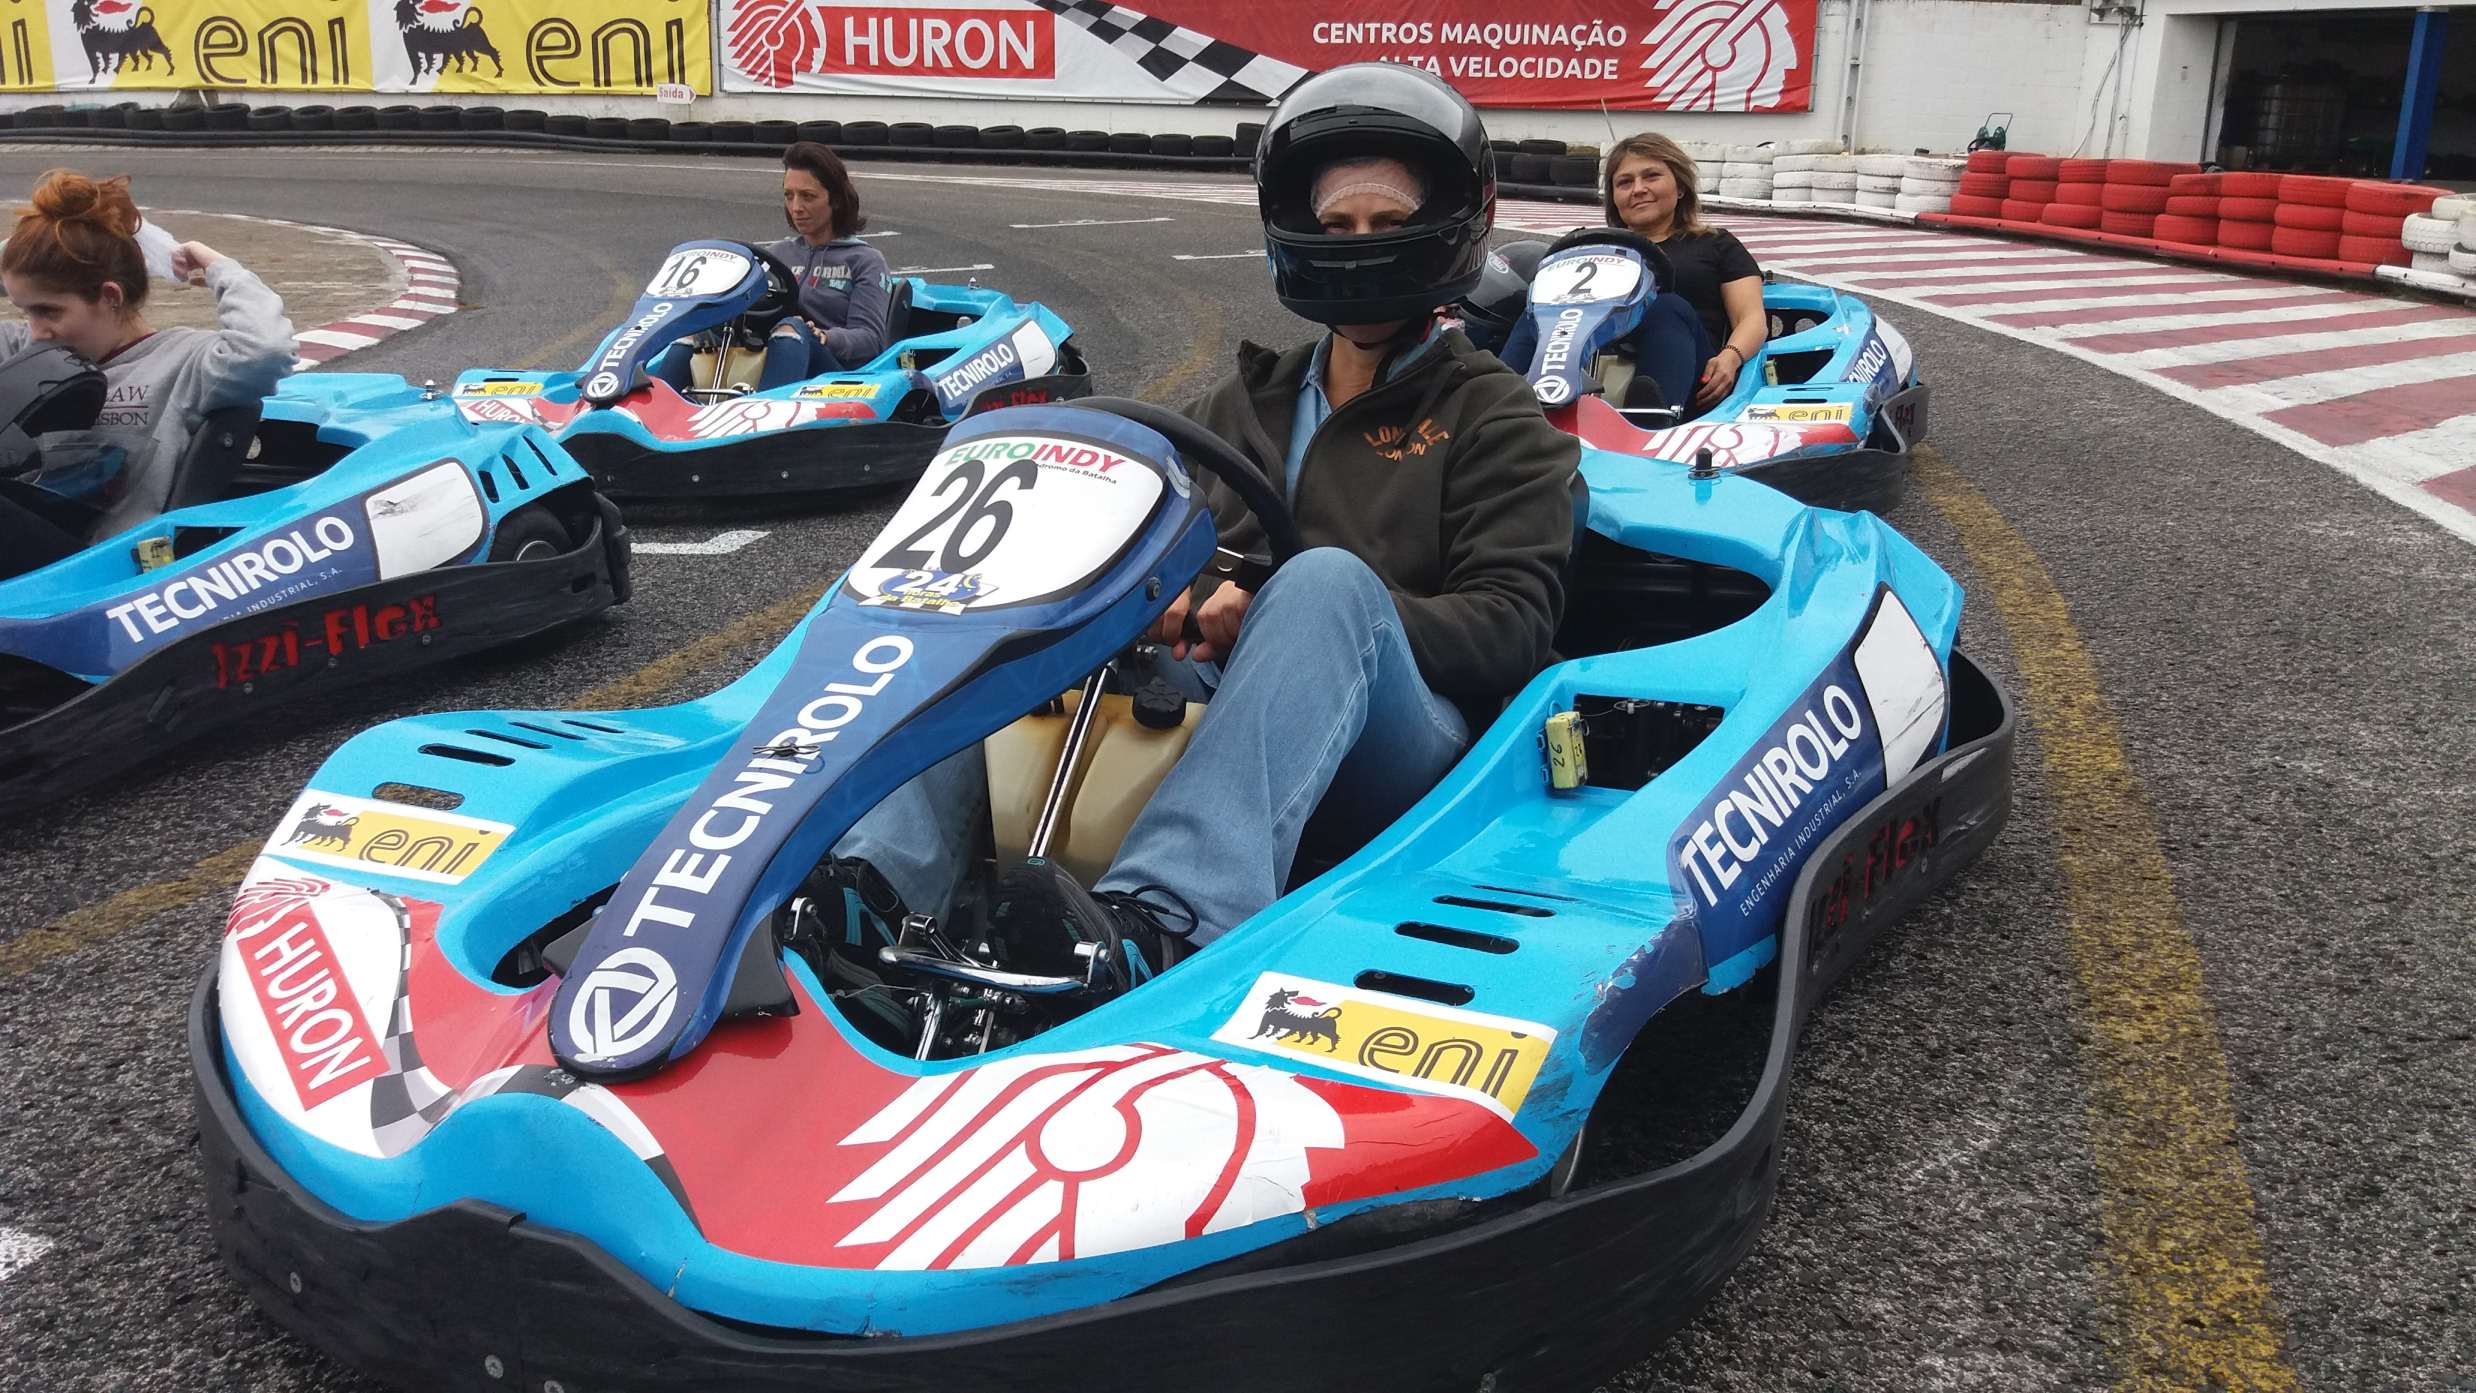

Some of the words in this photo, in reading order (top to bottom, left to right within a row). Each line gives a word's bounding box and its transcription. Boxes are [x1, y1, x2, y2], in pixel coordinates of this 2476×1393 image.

[197, 0, 351, 87] eni
[527, 0, 686, 87] eni
[843, 17, 1036, 70] HURON
[1312, 22, 1434, 46] CENTROS
[1440, 18, 1628, 51] MAQUINAÇÃO
[1380, 55, 1442, 78] TA
[1448, 55, 1619, 80] VELOCIDADE
[660, 256, 707, 290] 16
[1567, 261, 1598, 295] 2
[937, 342, 1015, 401] TECNIROLO
[1847, 339, 1888, 384] CNIROLO
[106, 384, 150, 402] AW
[475, 399, 529, 422] HUR
[1788, 405, 1843, 422] eni
[96, 411, 149, 426] ISBON
[944, 442, 1126, 474] EUROINDY
[1082, 470, 1118, 485] Batalha
[870, 459, 1039, 574] 26
[105, 516, 355, 644] TECNIROLO
[890, 569, 964, 596] 24
[623, 634, 915, 938] TECNIROLO
[1678, 684, 1863, 908] TECNIROLO
[357, 828, 491, 876] eni
[1739, 847, 1797, 917] ENGENHARIA
[1794, 789, 1846, 850] INDUSTRIAL,
[1844, 769, 1862, 790] S.A.
[254, 920, 373, 1091] HURON
[1357, 1025, 1529, 1100] eni
